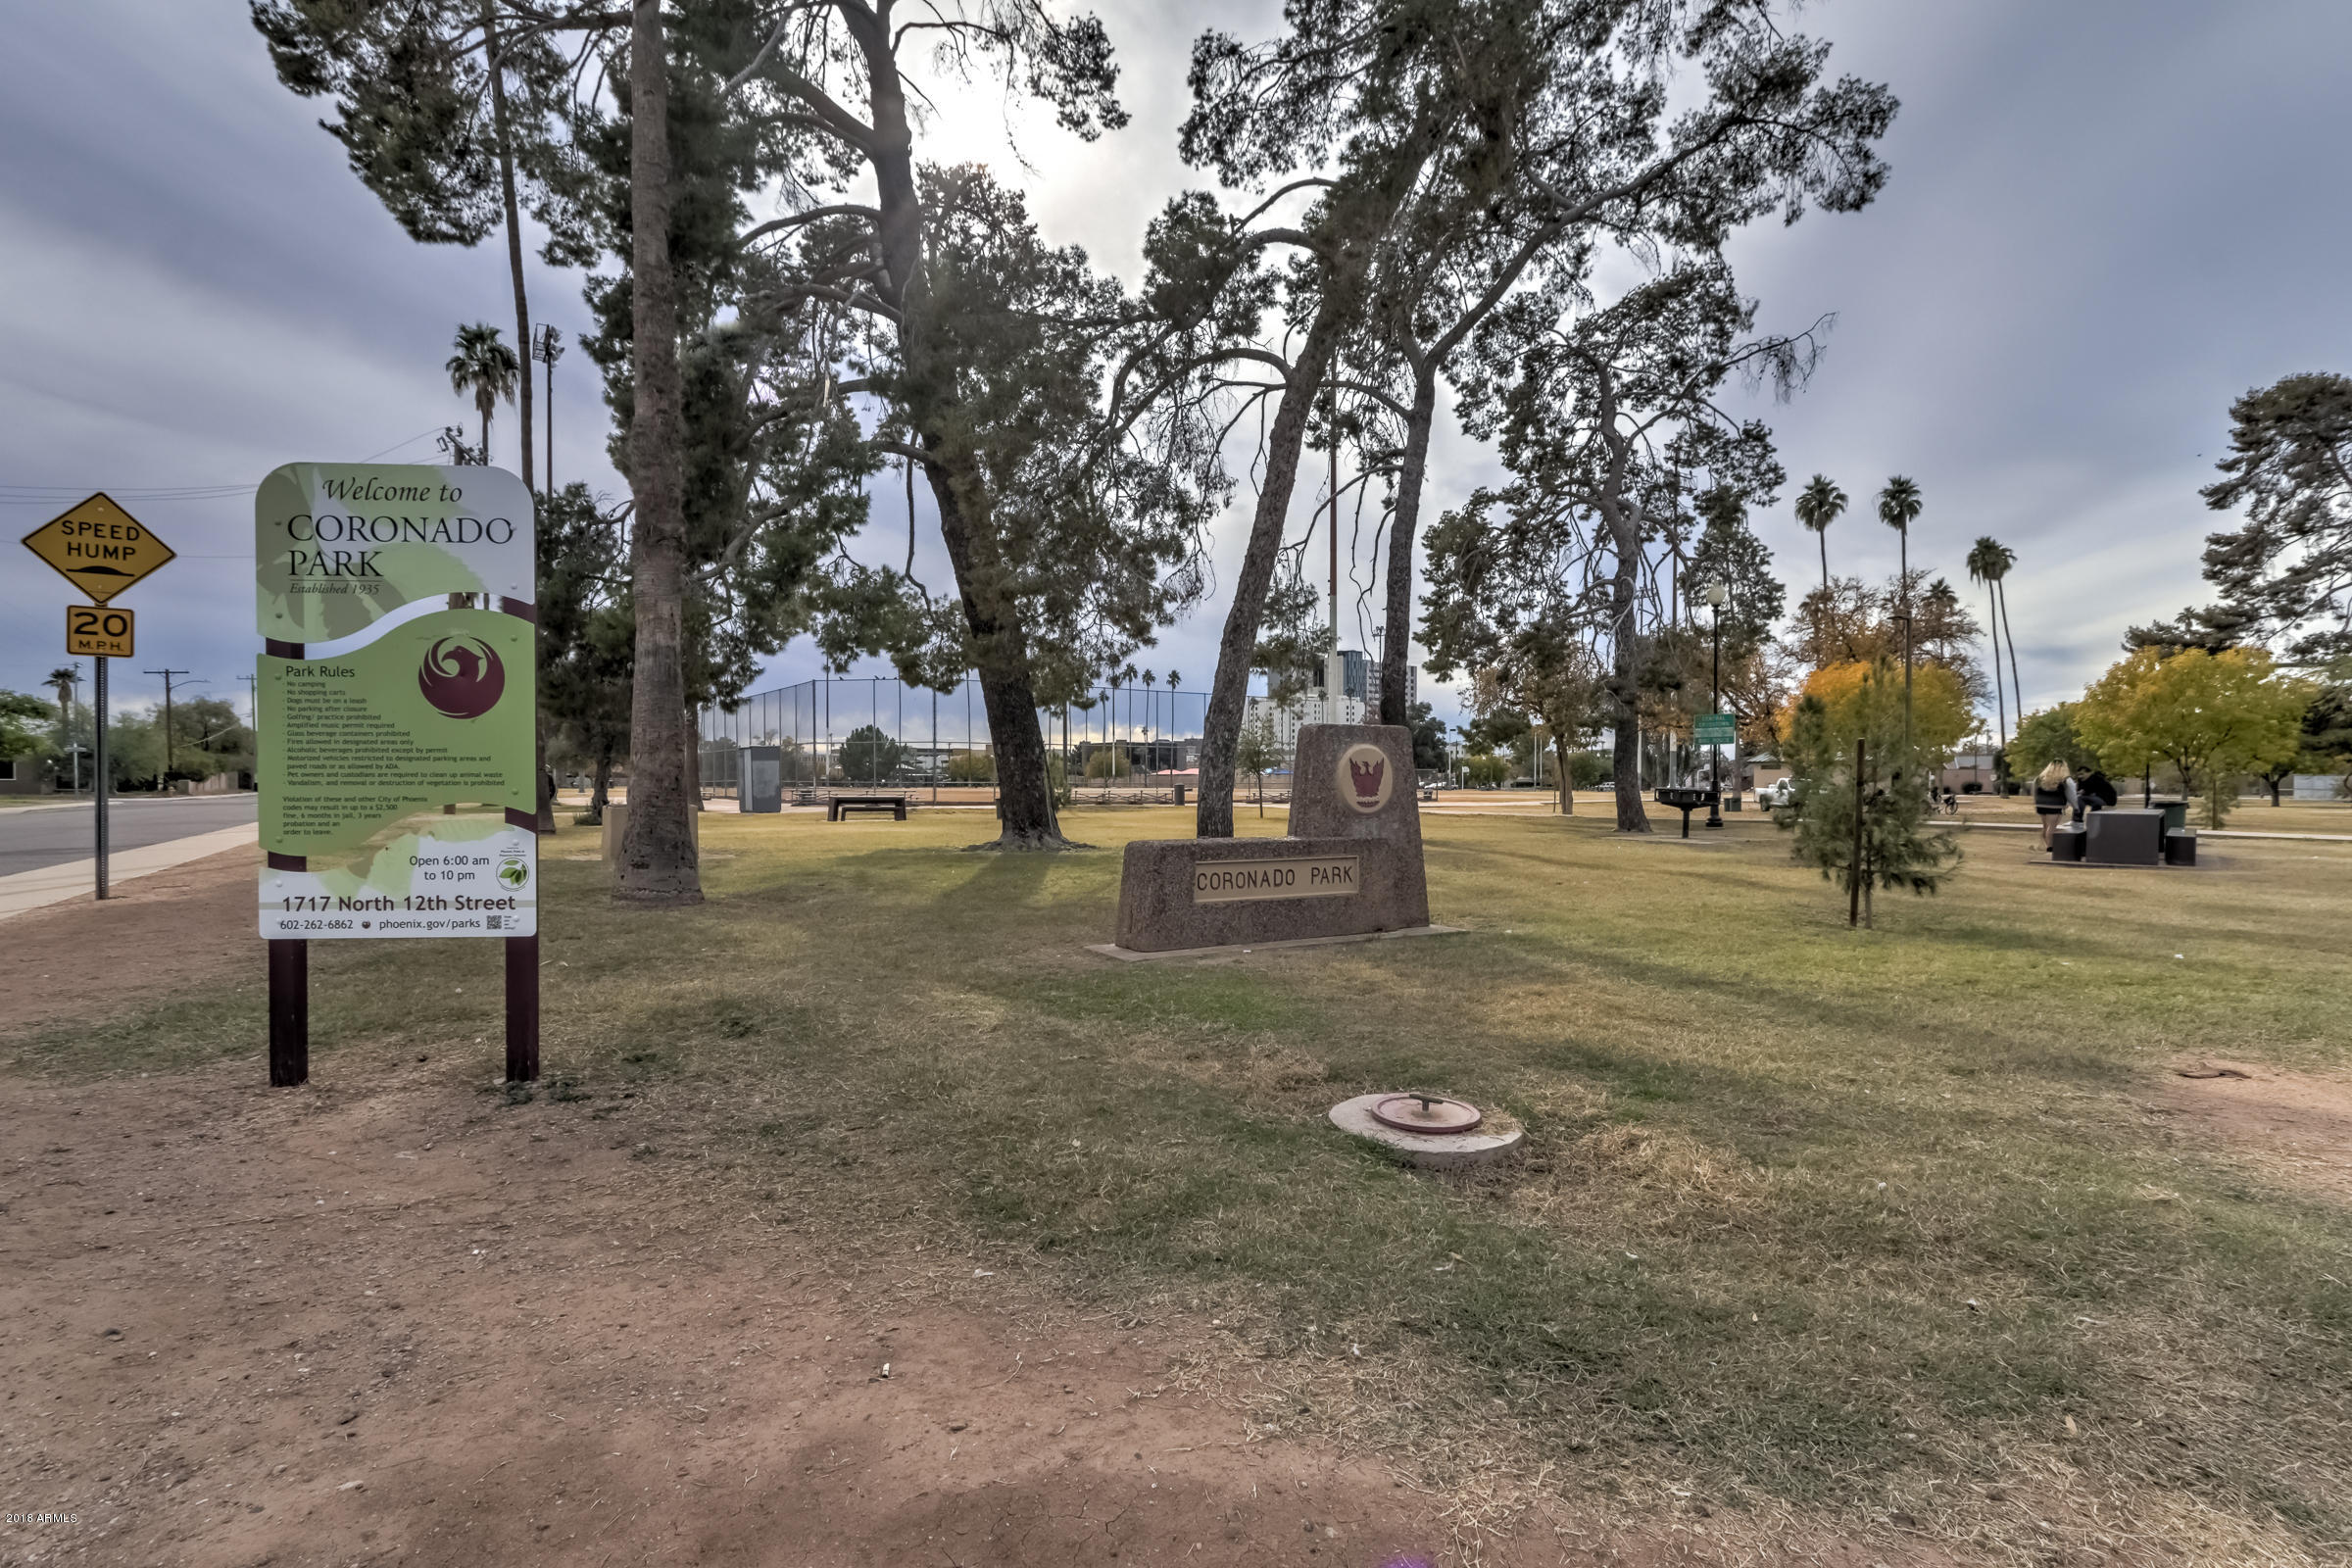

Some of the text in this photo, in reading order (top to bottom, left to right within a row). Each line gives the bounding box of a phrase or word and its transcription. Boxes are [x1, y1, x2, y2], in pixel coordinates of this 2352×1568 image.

[322, 477, 463, 503] Welcome to
[61, 519, 140, 541] SPEED
[287, 514, 514, 544] CORONADO
[67, 541, 136, 561] HUMP
[288, 550, 383, 577] PARK
[290, 583, 380, 595] Established 1935
[74, 612, 127, 637] 20
[285, 665, 355, 677] Park Rules
[409, 856, 439, 867] Open
[443, 856, 468, 865] 6:00
[424, 870, 475, 882] to 10 pm
[1197, 865, 1353, 891] CORONADO PARK
[282, 895, 515, 911] 1717 North 12th Street
[280, 919, 481, 930] 602-262-6862 phoenix.gov/parks
